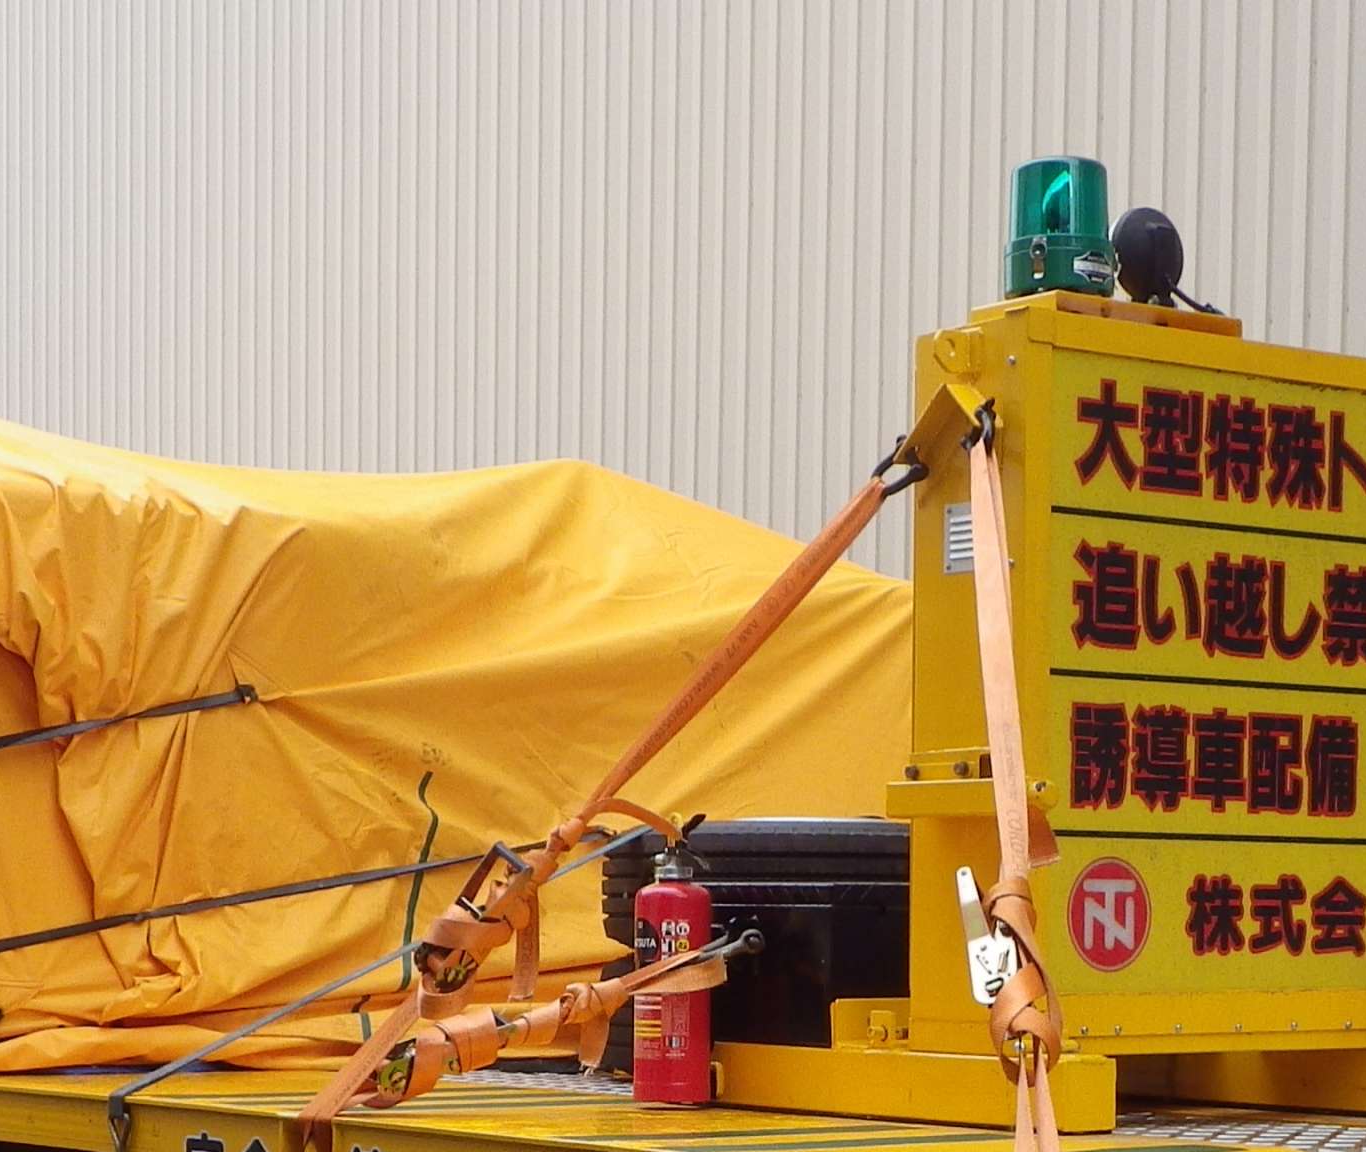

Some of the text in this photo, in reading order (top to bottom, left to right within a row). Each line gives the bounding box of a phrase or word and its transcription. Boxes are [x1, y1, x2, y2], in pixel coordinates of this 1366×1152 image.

[1070, 701, 1359, 818] 誘導車配備
